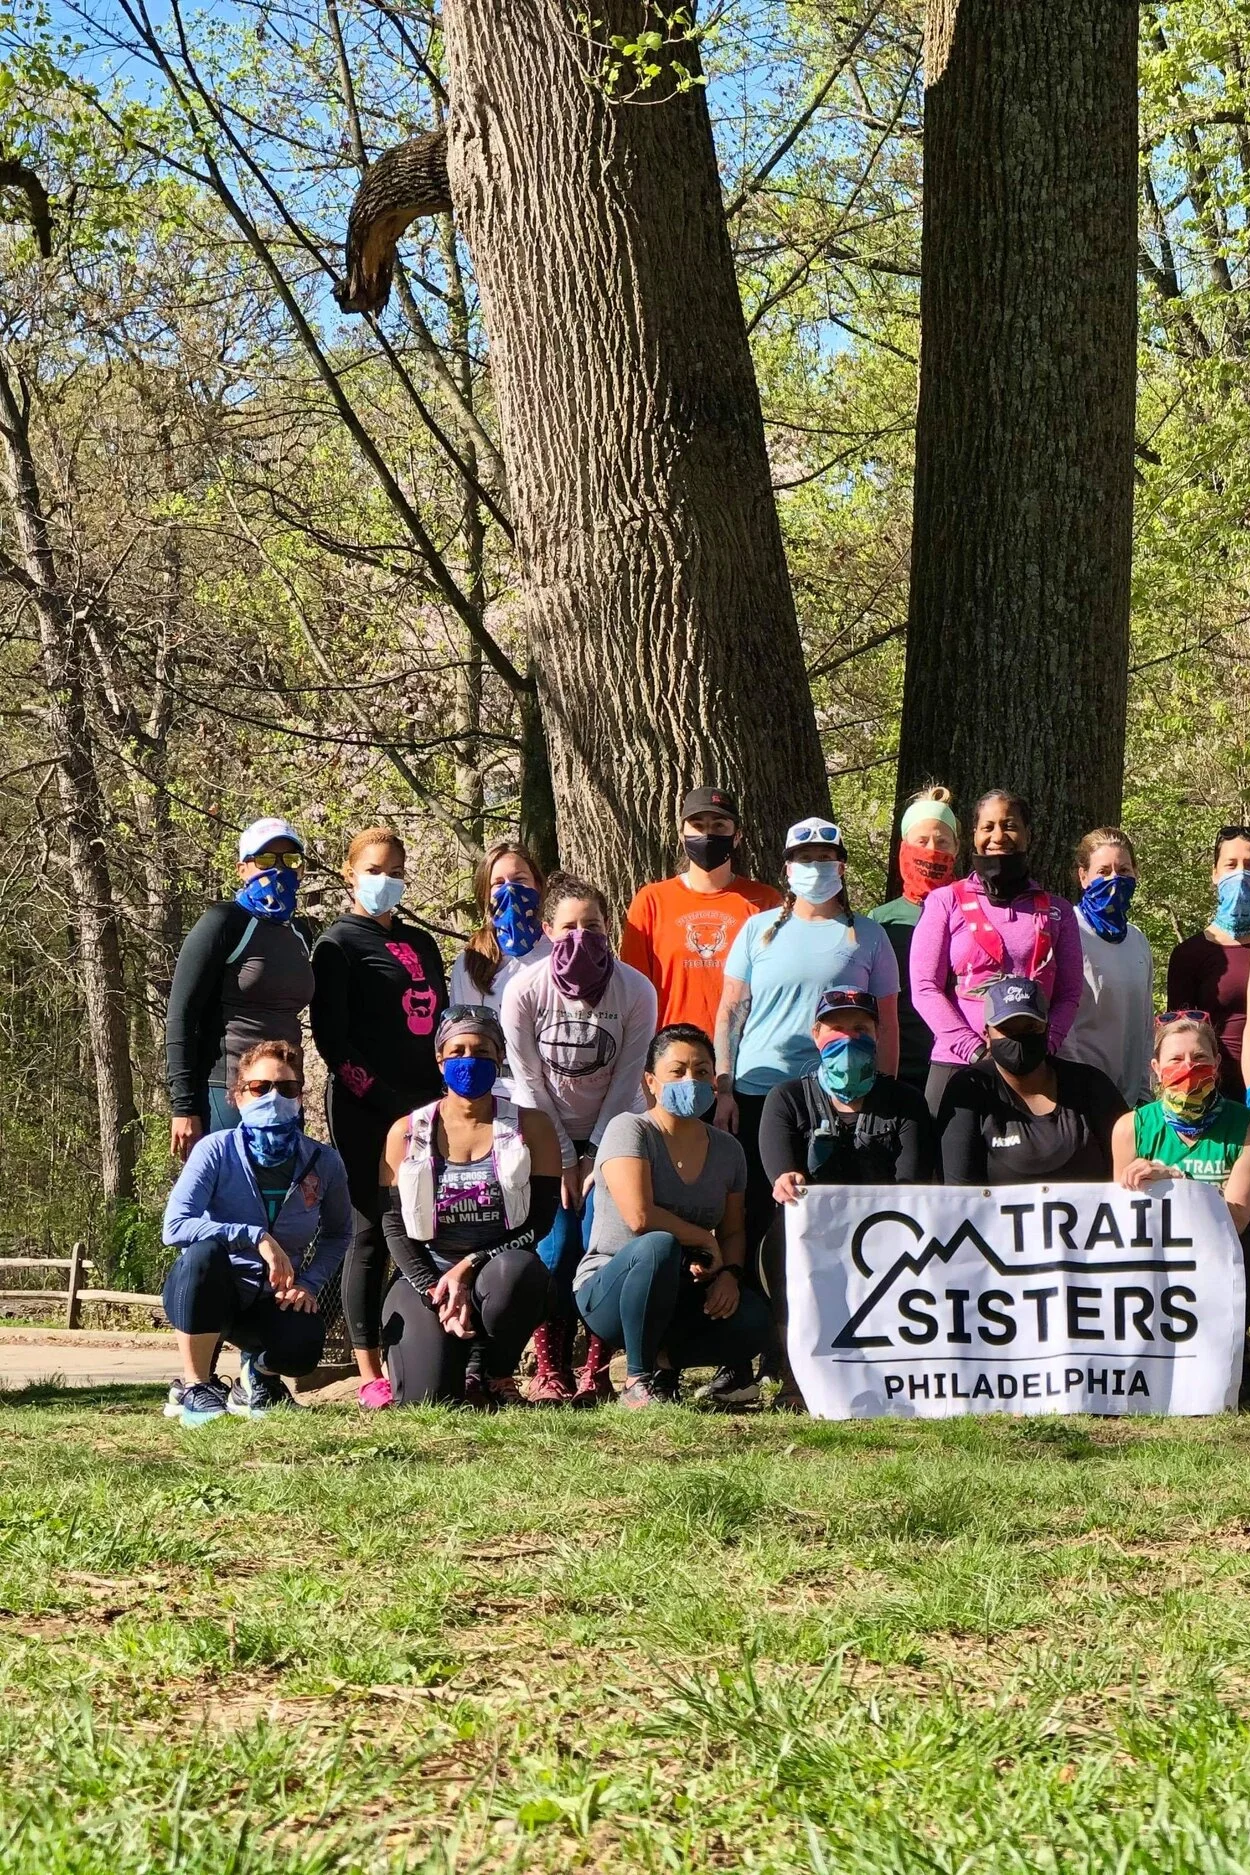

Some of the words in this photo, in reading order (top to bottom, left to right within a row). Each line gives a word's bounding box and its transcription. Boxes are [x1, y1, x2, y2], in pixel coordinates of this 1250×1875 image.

[460, 1171, 488, 1182] CROSS
[1183, 1160, 1231, 1174] TRAIL
[459, 1211, 500, 1222] MILER
[1000, 1198, 1194, 1252] TRAIL
[898, 1285, 1198, 1346] SISTERS
[884, 1367, 1151, 1400] PHILADELPHIA
